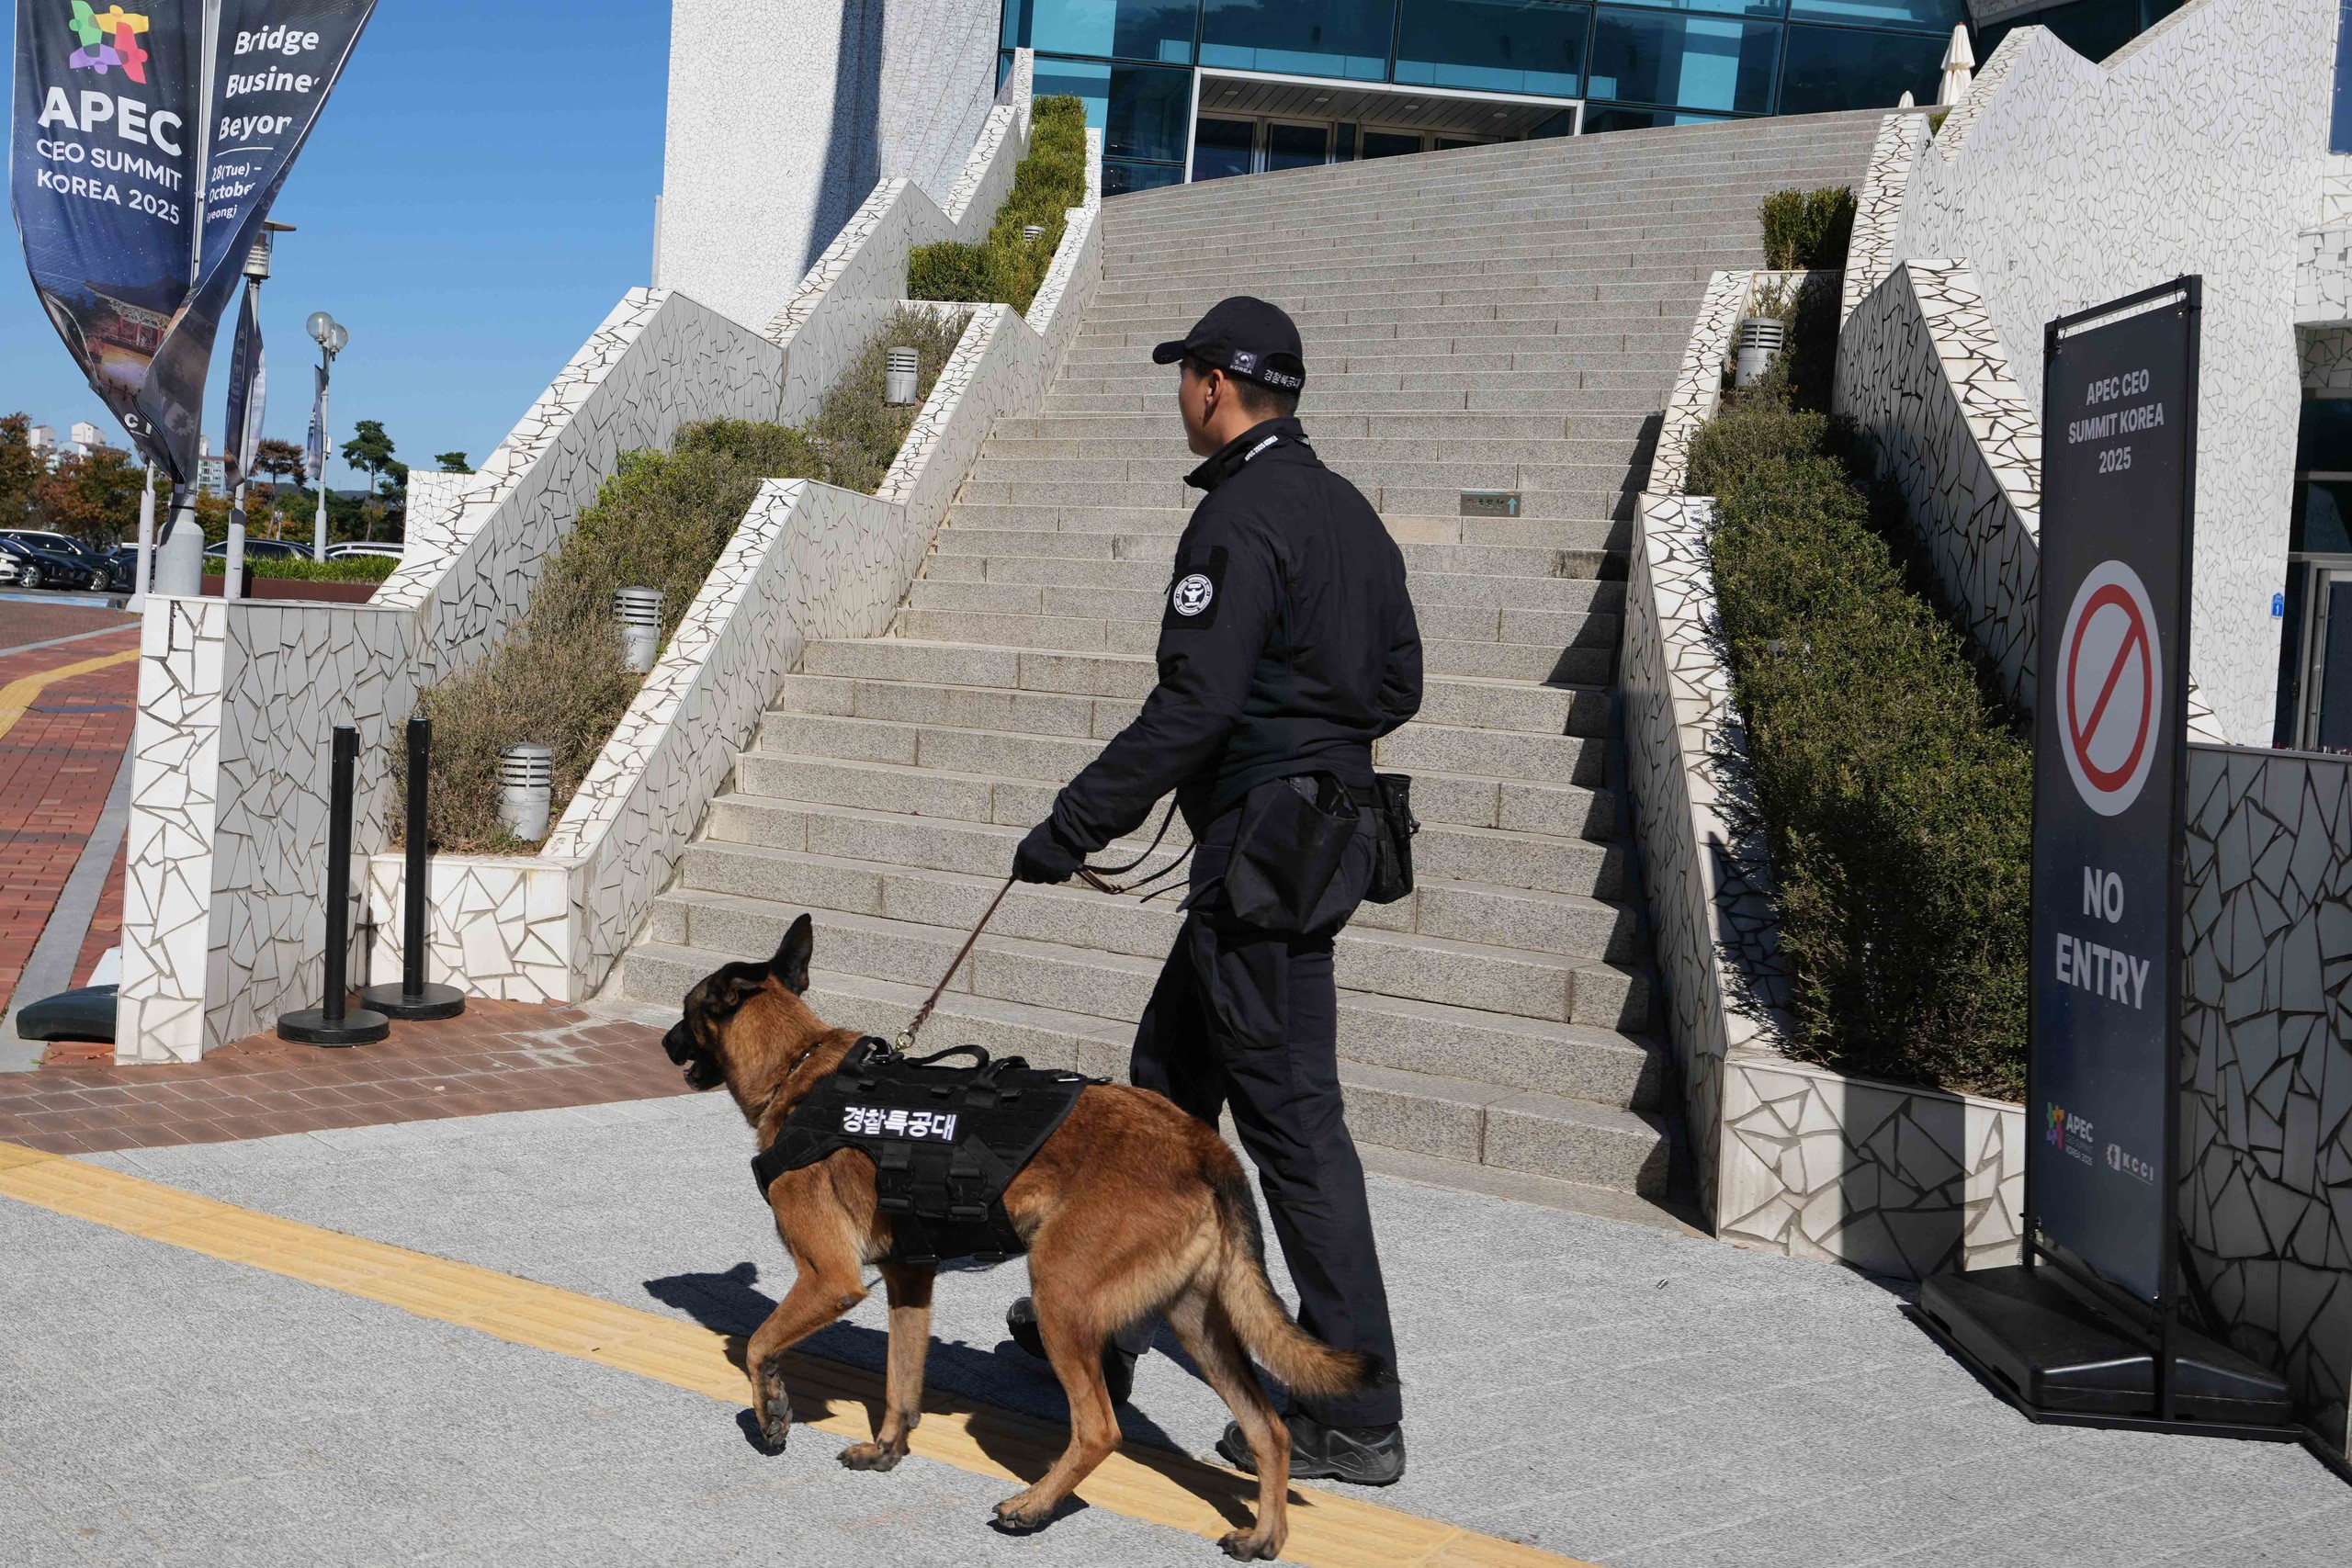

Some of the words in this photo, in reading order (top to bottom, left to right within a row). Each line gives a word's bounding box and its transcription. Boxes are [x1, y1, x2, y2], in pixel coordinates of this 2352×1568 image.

[233, 24, 320, 55] Bridge
[225, 65, 321, 98] Busine
[38, 86, 183, 157] APEC
[37, 139, 85, 164] CEO
[90, 148, 182, 191] SUMMIT
[211, 162, 250, 183] 28(Tue)
[38, 168, 121, 205] KOREA
[129, 189, 180, 225] 2025
[1229, 364, 1252, 375] KOREA
[1264, 369, 1302, 389] 경찰특공대
[2086, 376, 2120, 406] APEC
[2121, 368, 2150, 396] CEO
[2068, 412, 2119, 445] SUMMIT
[2120, 402, 2165, 434] KOREA
[2098, 446, 2132, 473] 2025
[2083, 865, 2124, 924] NO
[2055, 932, 2151, 1010] ENTRY
[843, 1106, 957, 1141] 경찰특공대
[2065, 1112, 2094, 1143] APEC
[2122, 1152, 2154, 1181] KCCI
